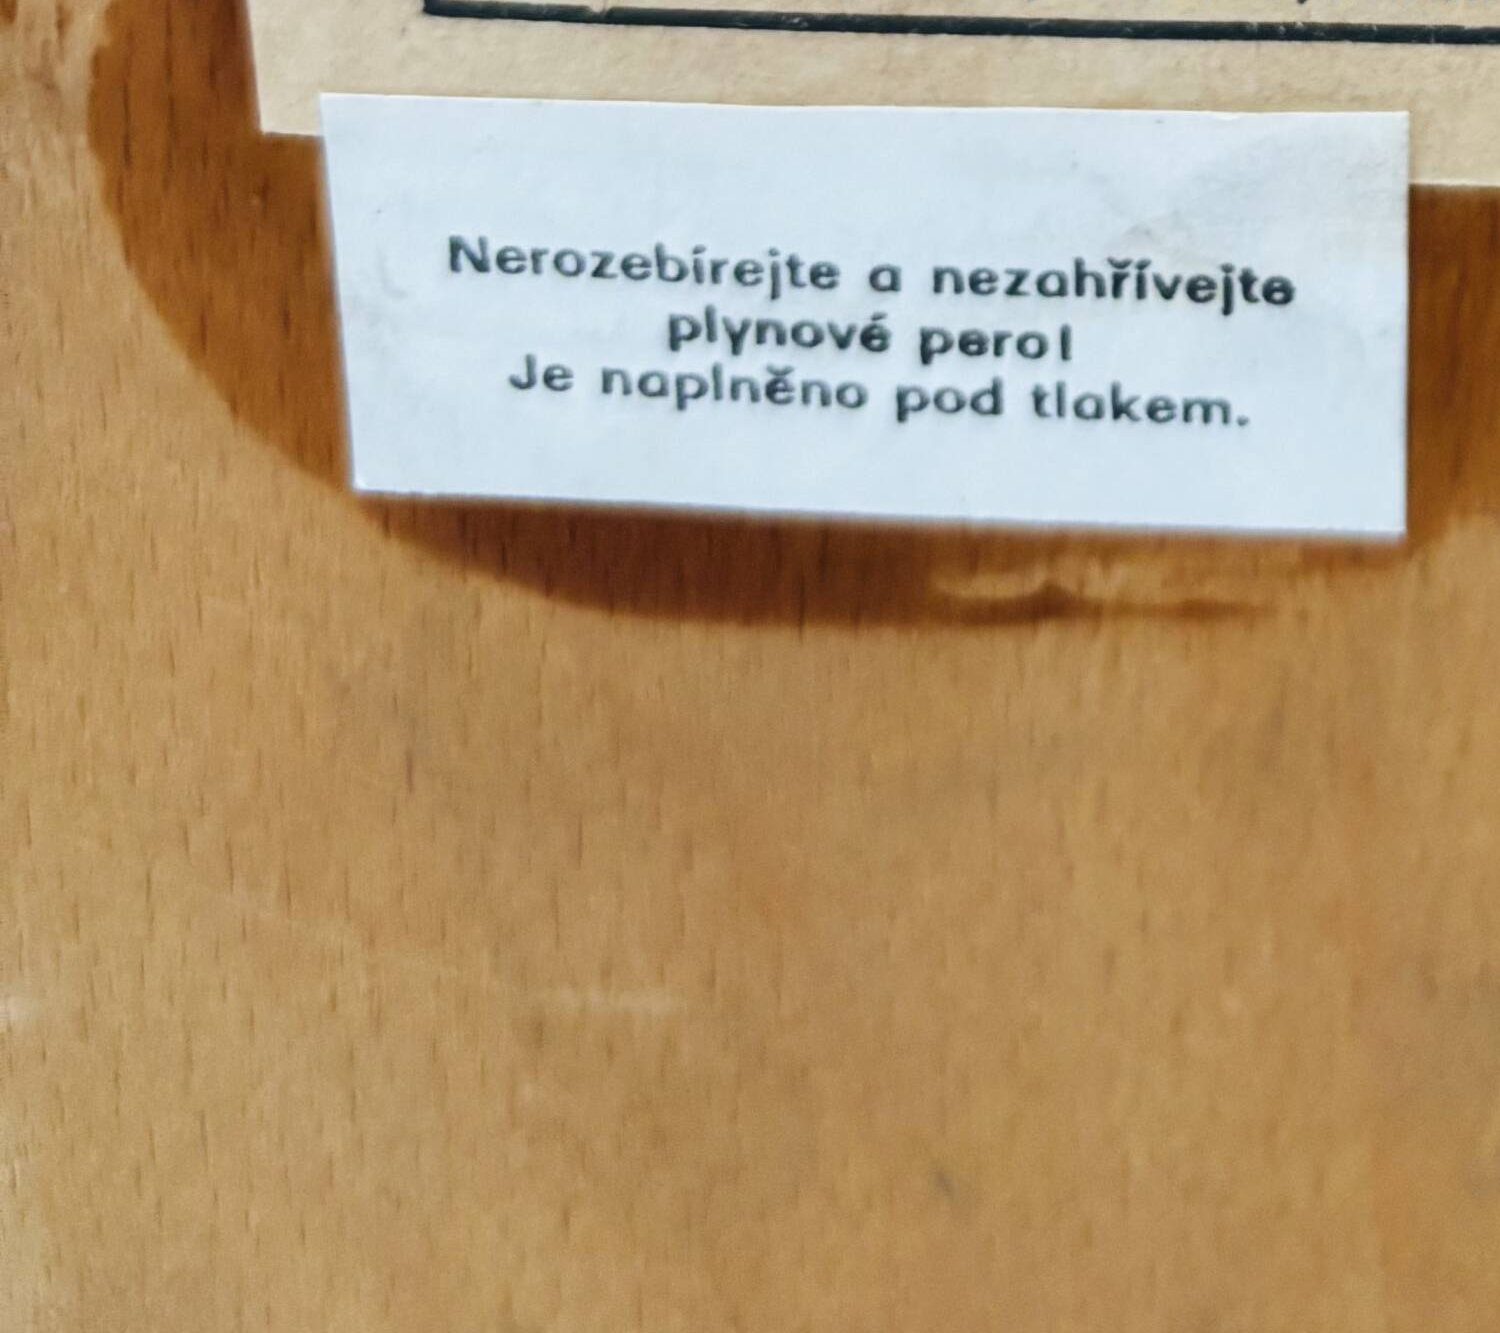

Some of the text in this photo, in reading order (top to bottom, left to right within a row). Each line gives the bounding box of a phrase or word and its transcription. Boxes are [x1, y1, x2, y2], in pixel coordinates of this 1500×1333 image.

[447, 234, 1298, 319] Nerozebírejte a nezahřívejte
[666, 303, 893, 359] plynové
[507, 352, 1250, 429] Je naplněno pod tlakem.
